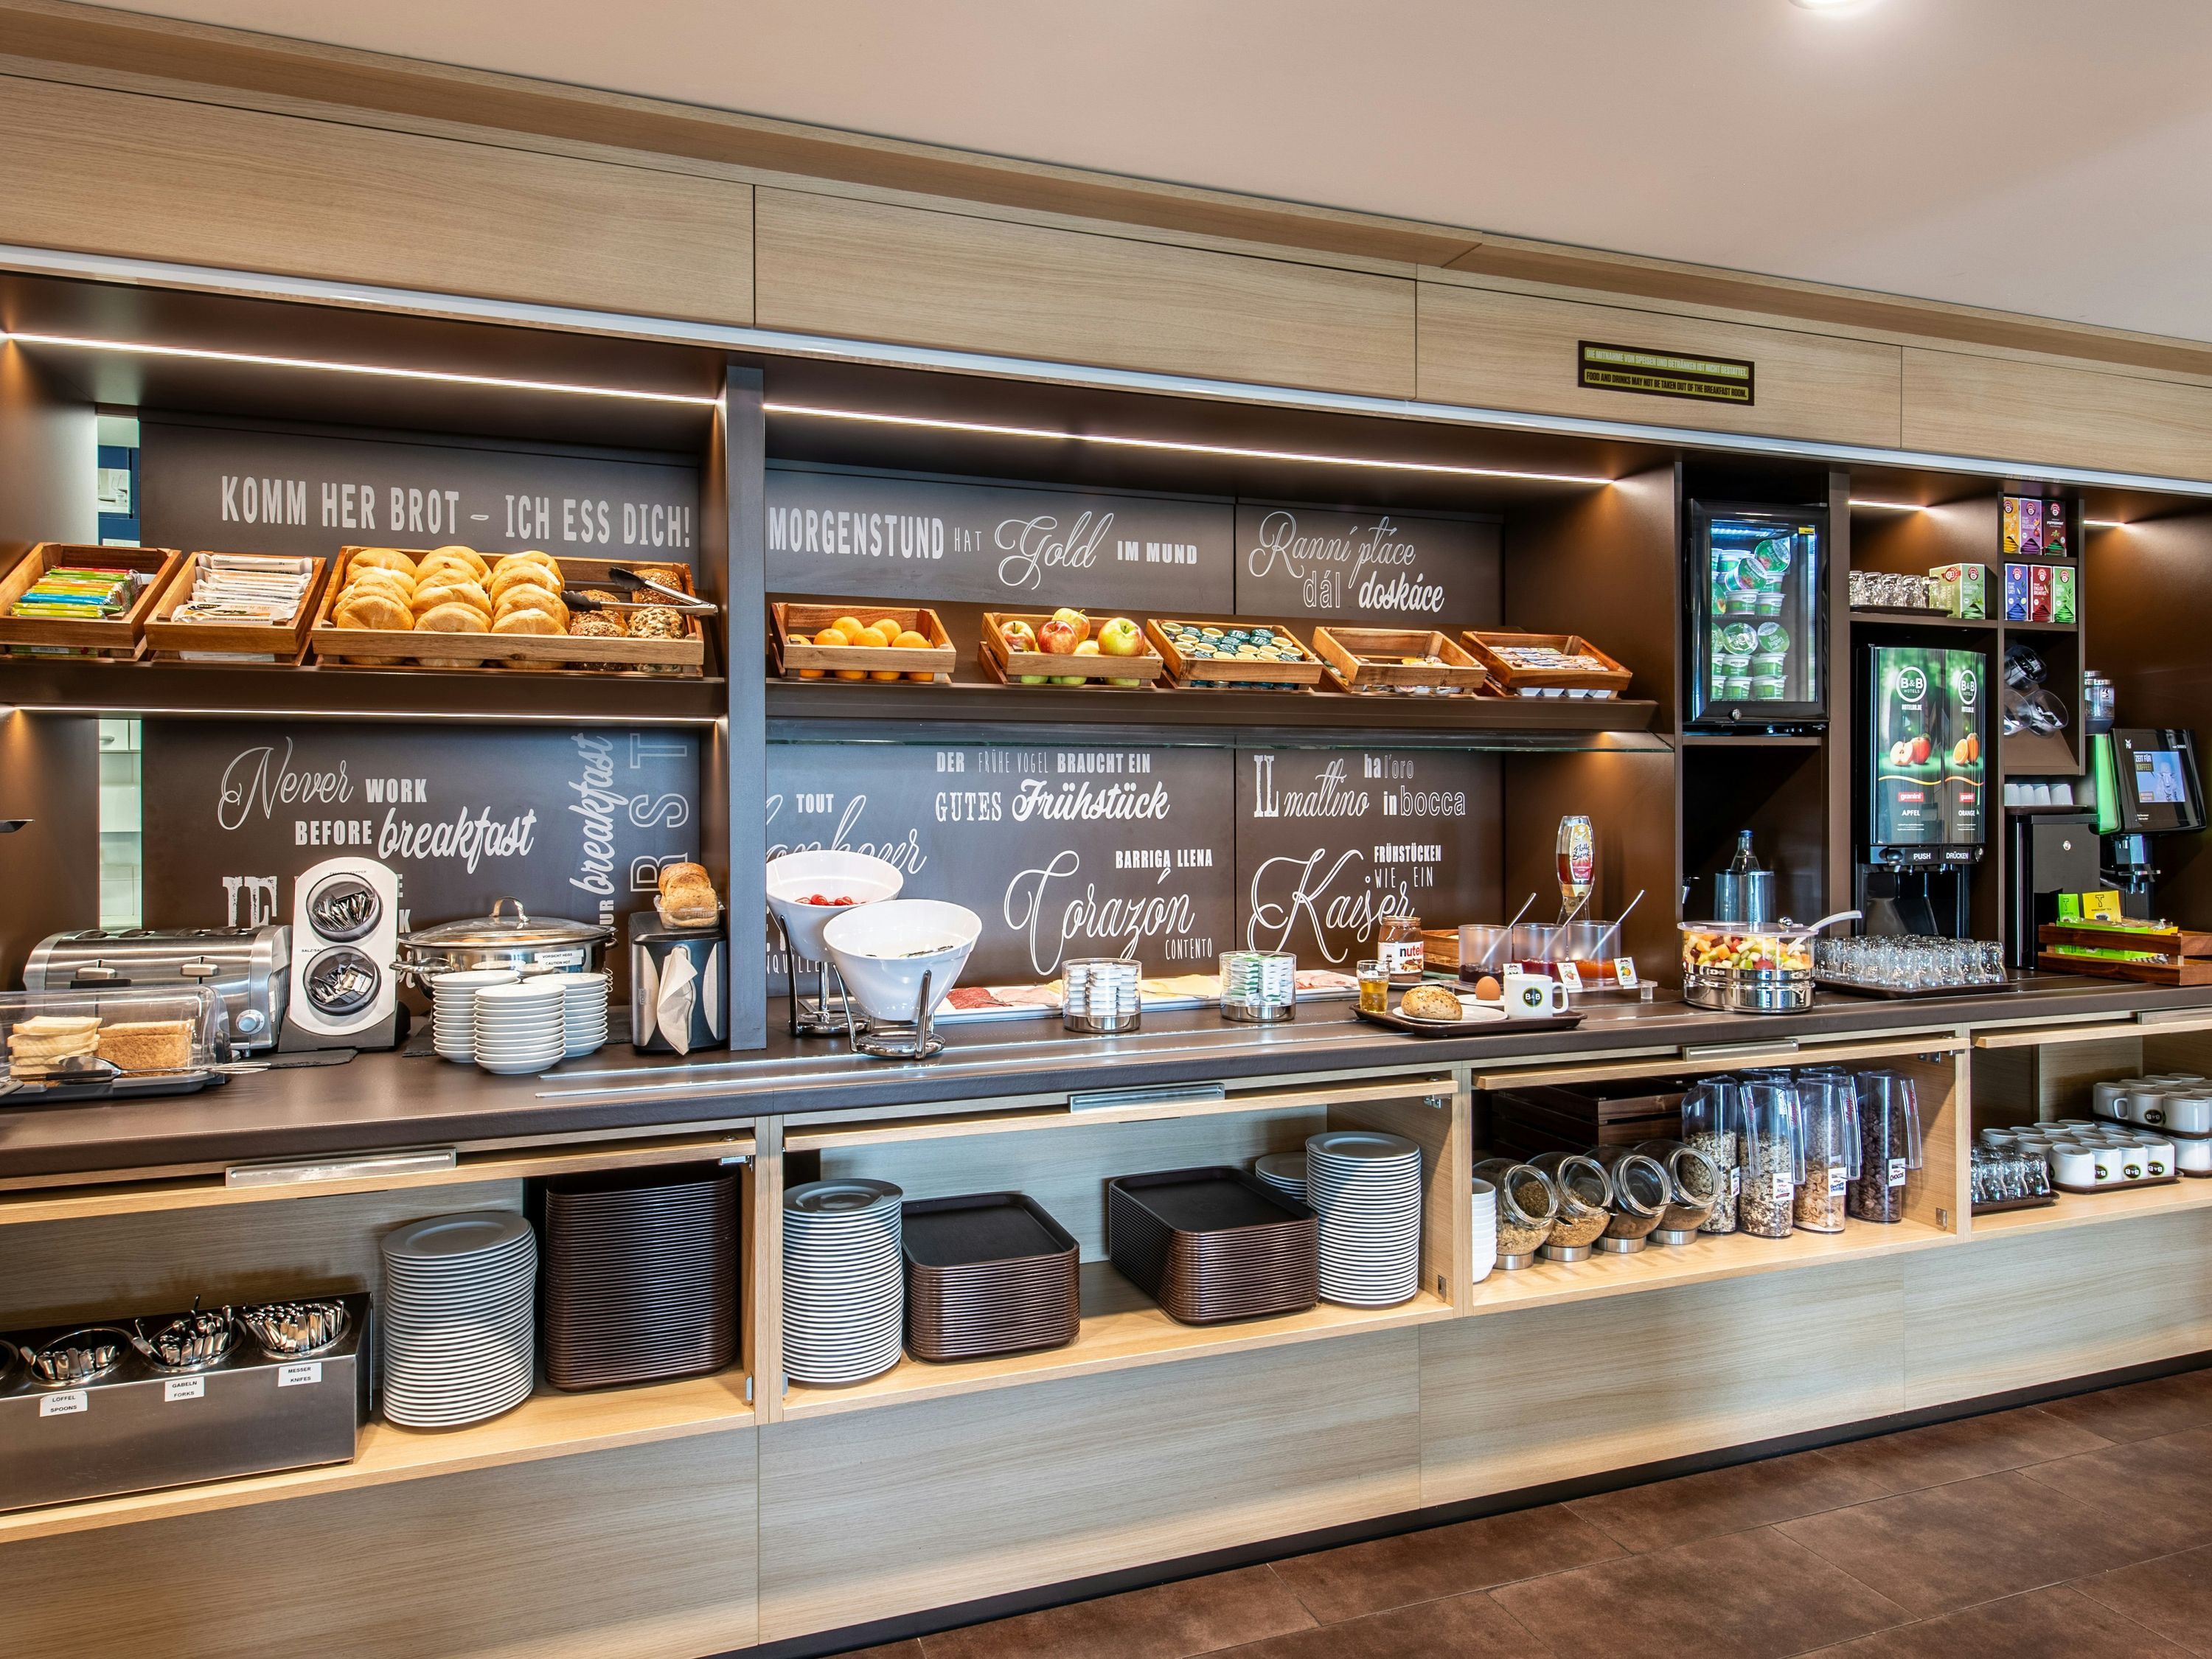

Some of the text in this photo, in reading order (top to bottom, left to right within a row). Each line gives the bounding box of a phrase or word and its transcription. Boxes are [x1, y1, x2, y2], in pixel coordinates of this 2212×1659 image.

[1635, 355, 1656, 366] SPEISEN
[1586, 372, 1600, 380] FOOD
[1600, 373, 1612, 382] AND
[1612, 375, 1631, 384] DRINKS
[1631, 376, 1643, 386] MAY
[1643, 378, 1653, 387] NOT
[1654, 379, 1660, 388] BE
[1661, 380, 1677, 389] TAKEN
[1677, 382, 1687, 391] OUT
[1687, 383, 1694, 392] OF
[1694, 384, 1704, 393] THE
[1704, 385, 1731, 396] BREAKFAST
[222, 476, 307, 526] KOMM
[322, 482, 376, 529] HER
[391, 488, 459, 535] BROT
[506, 495, 550, 540] ICH
[563, 498, 610, 544] ESS
[623, 503, 691, 548] DICH!
[770, 507, 1197, 590] MORGENSTUND HAT Gold IM MUND
[1248, 511, 1358, 578] Ranní
[1303, 570, 1340, 608] dál
[1901, 678, 1923, 689] B&B
[1961, 680, 1975, 692] B&B
[936, 748, 1150, 773] DER FRÜHE VOGEL BRAUCHT EIN
[2143, 754, 2152, 762] FÜR
[218, 737, 427, 830] Never WORK
[1284, 759, 1370, 817] mattino
[1364, 754, 1381, 779] ha
[796, 794, 834, 813] TOUT
[936, 779, 1171, 821] GUTES Frühstück
[1383, 786, 1465, 815] in bocca
[568, 732, 628, 895] breakfast
[296, 806, 537, 874] BEFORE breakfast
[1116, 849, 1212, 869] BARRIGA LLENA
[1374, 844, 1441, 863] FRÜHSTÜCKEN
[1946, 852, 1969, 860] DRÜCKEN
[1374, 866, 1433, 888] WIE EIN
[1004, 850, 1196, 975] Corazón
[1247, 848, 1415, 963] Kaiser
[1166, 939, 1212, 961] CONTENTO
[288, 1366, 311, 1374] MESSER
[172, 1380, 198, 1388] GABELN
[50, 1404, 77, 1413] SPOONS
